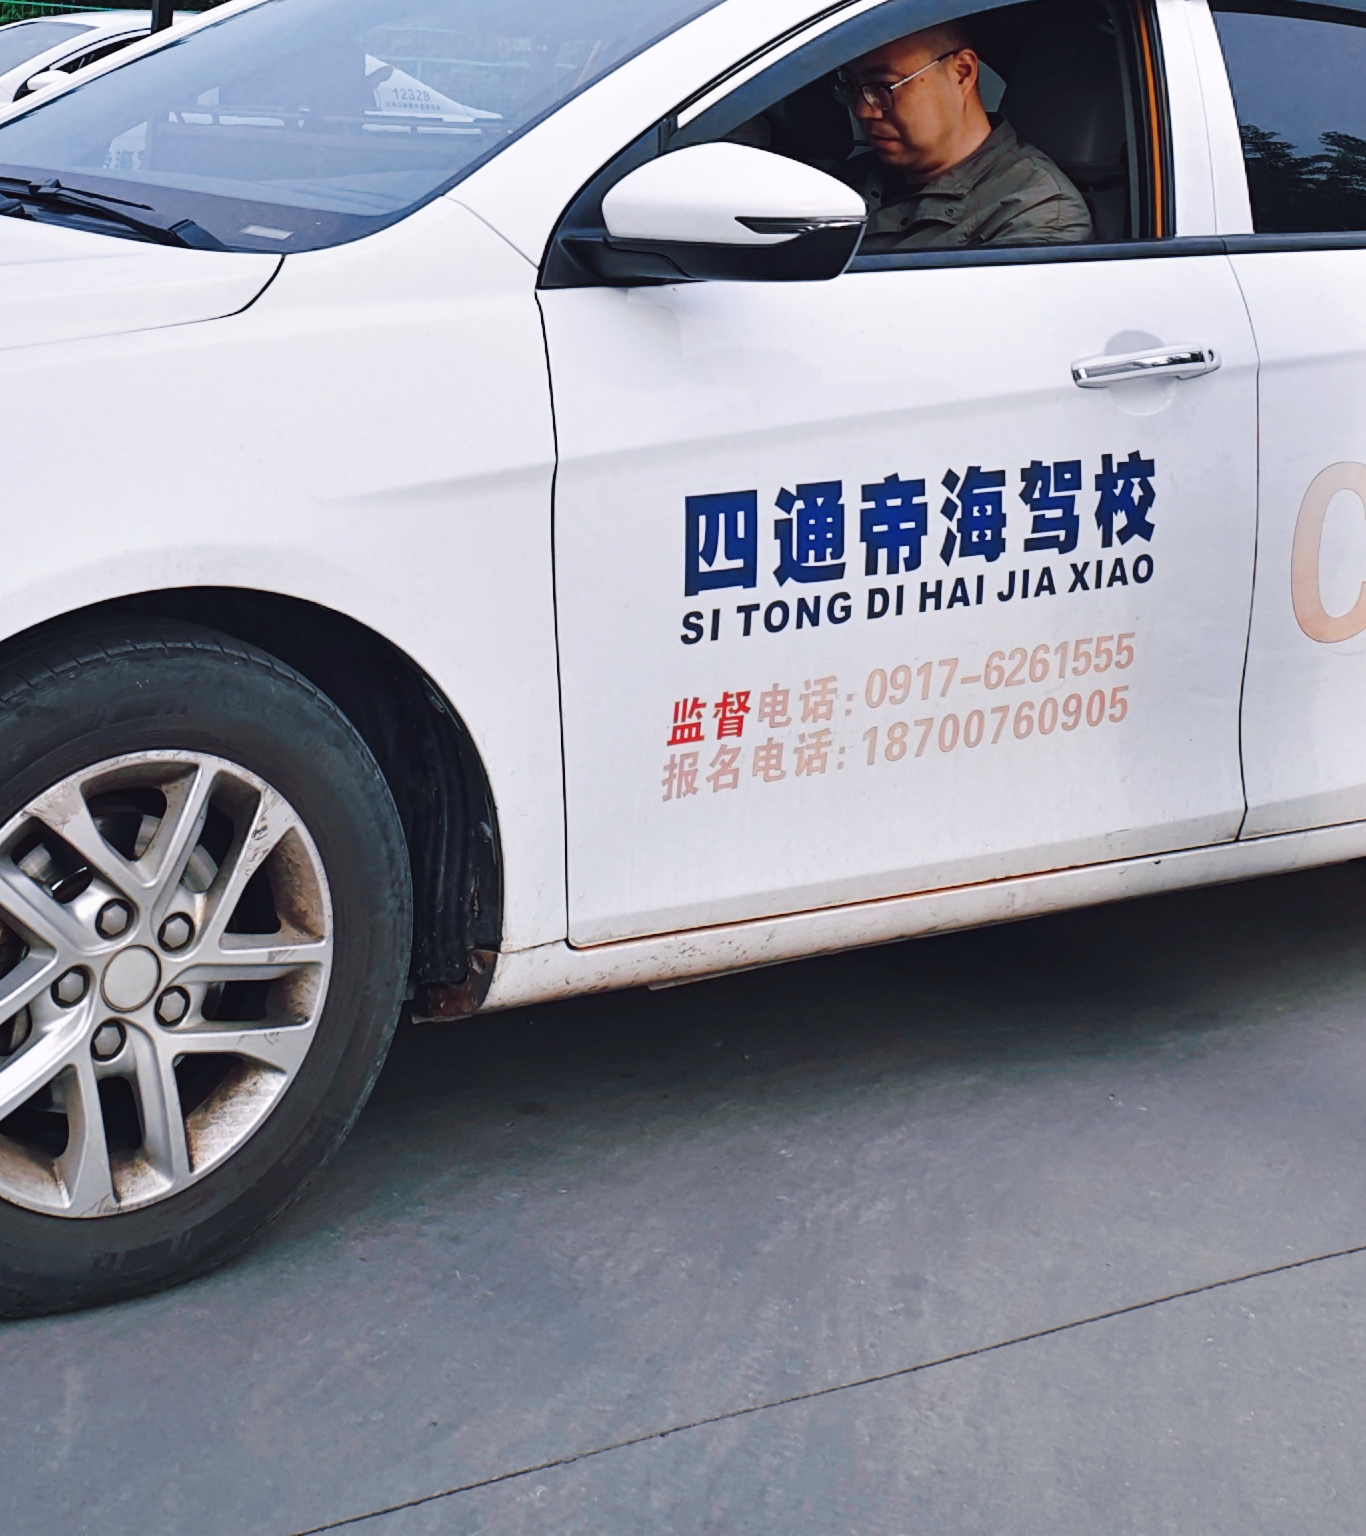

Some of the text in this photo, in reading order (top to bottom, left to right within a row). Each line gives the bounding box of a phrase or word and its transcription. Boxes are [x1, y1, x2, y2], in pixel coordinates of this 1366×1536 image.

[392, 87, 431, 102] 12328
[684, 449, 1157, 598] 四通帝海驾校
[680, 553, 1154, 645] SI TONG DI HAI JIA XIAO
